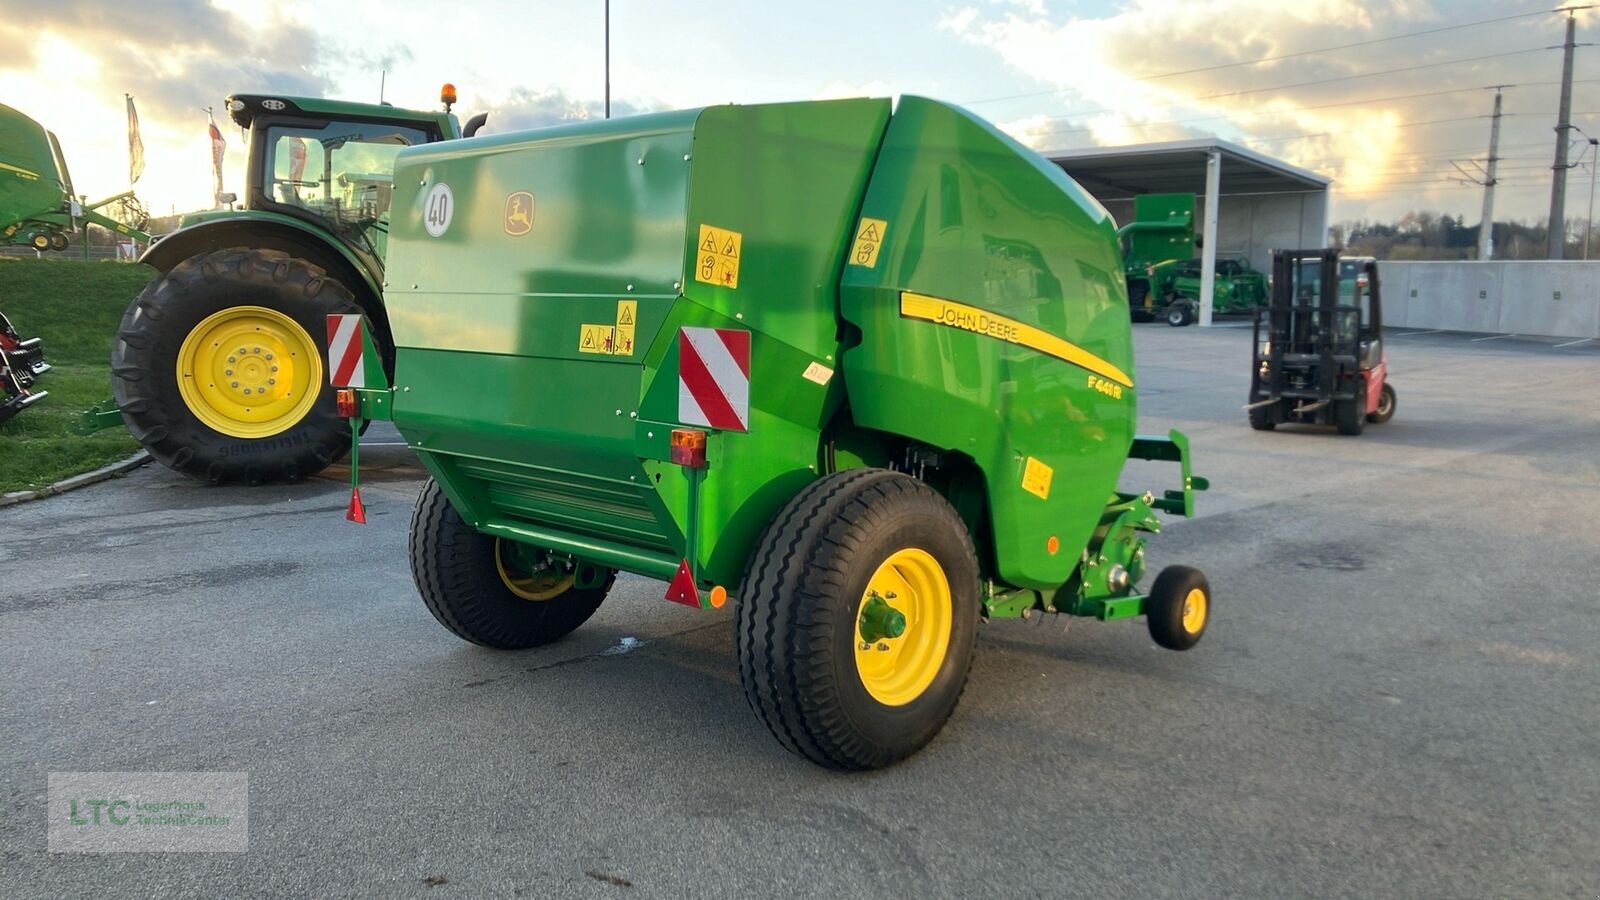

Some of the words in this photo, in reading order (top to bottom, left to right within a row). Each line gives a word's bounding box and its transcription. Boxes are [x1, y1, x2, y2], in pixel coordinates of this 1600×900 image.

[428, 193, 448, 226] 40
[935, 304, 976, 329] JOHN
[979, 315, 1019, 341] DEERE
